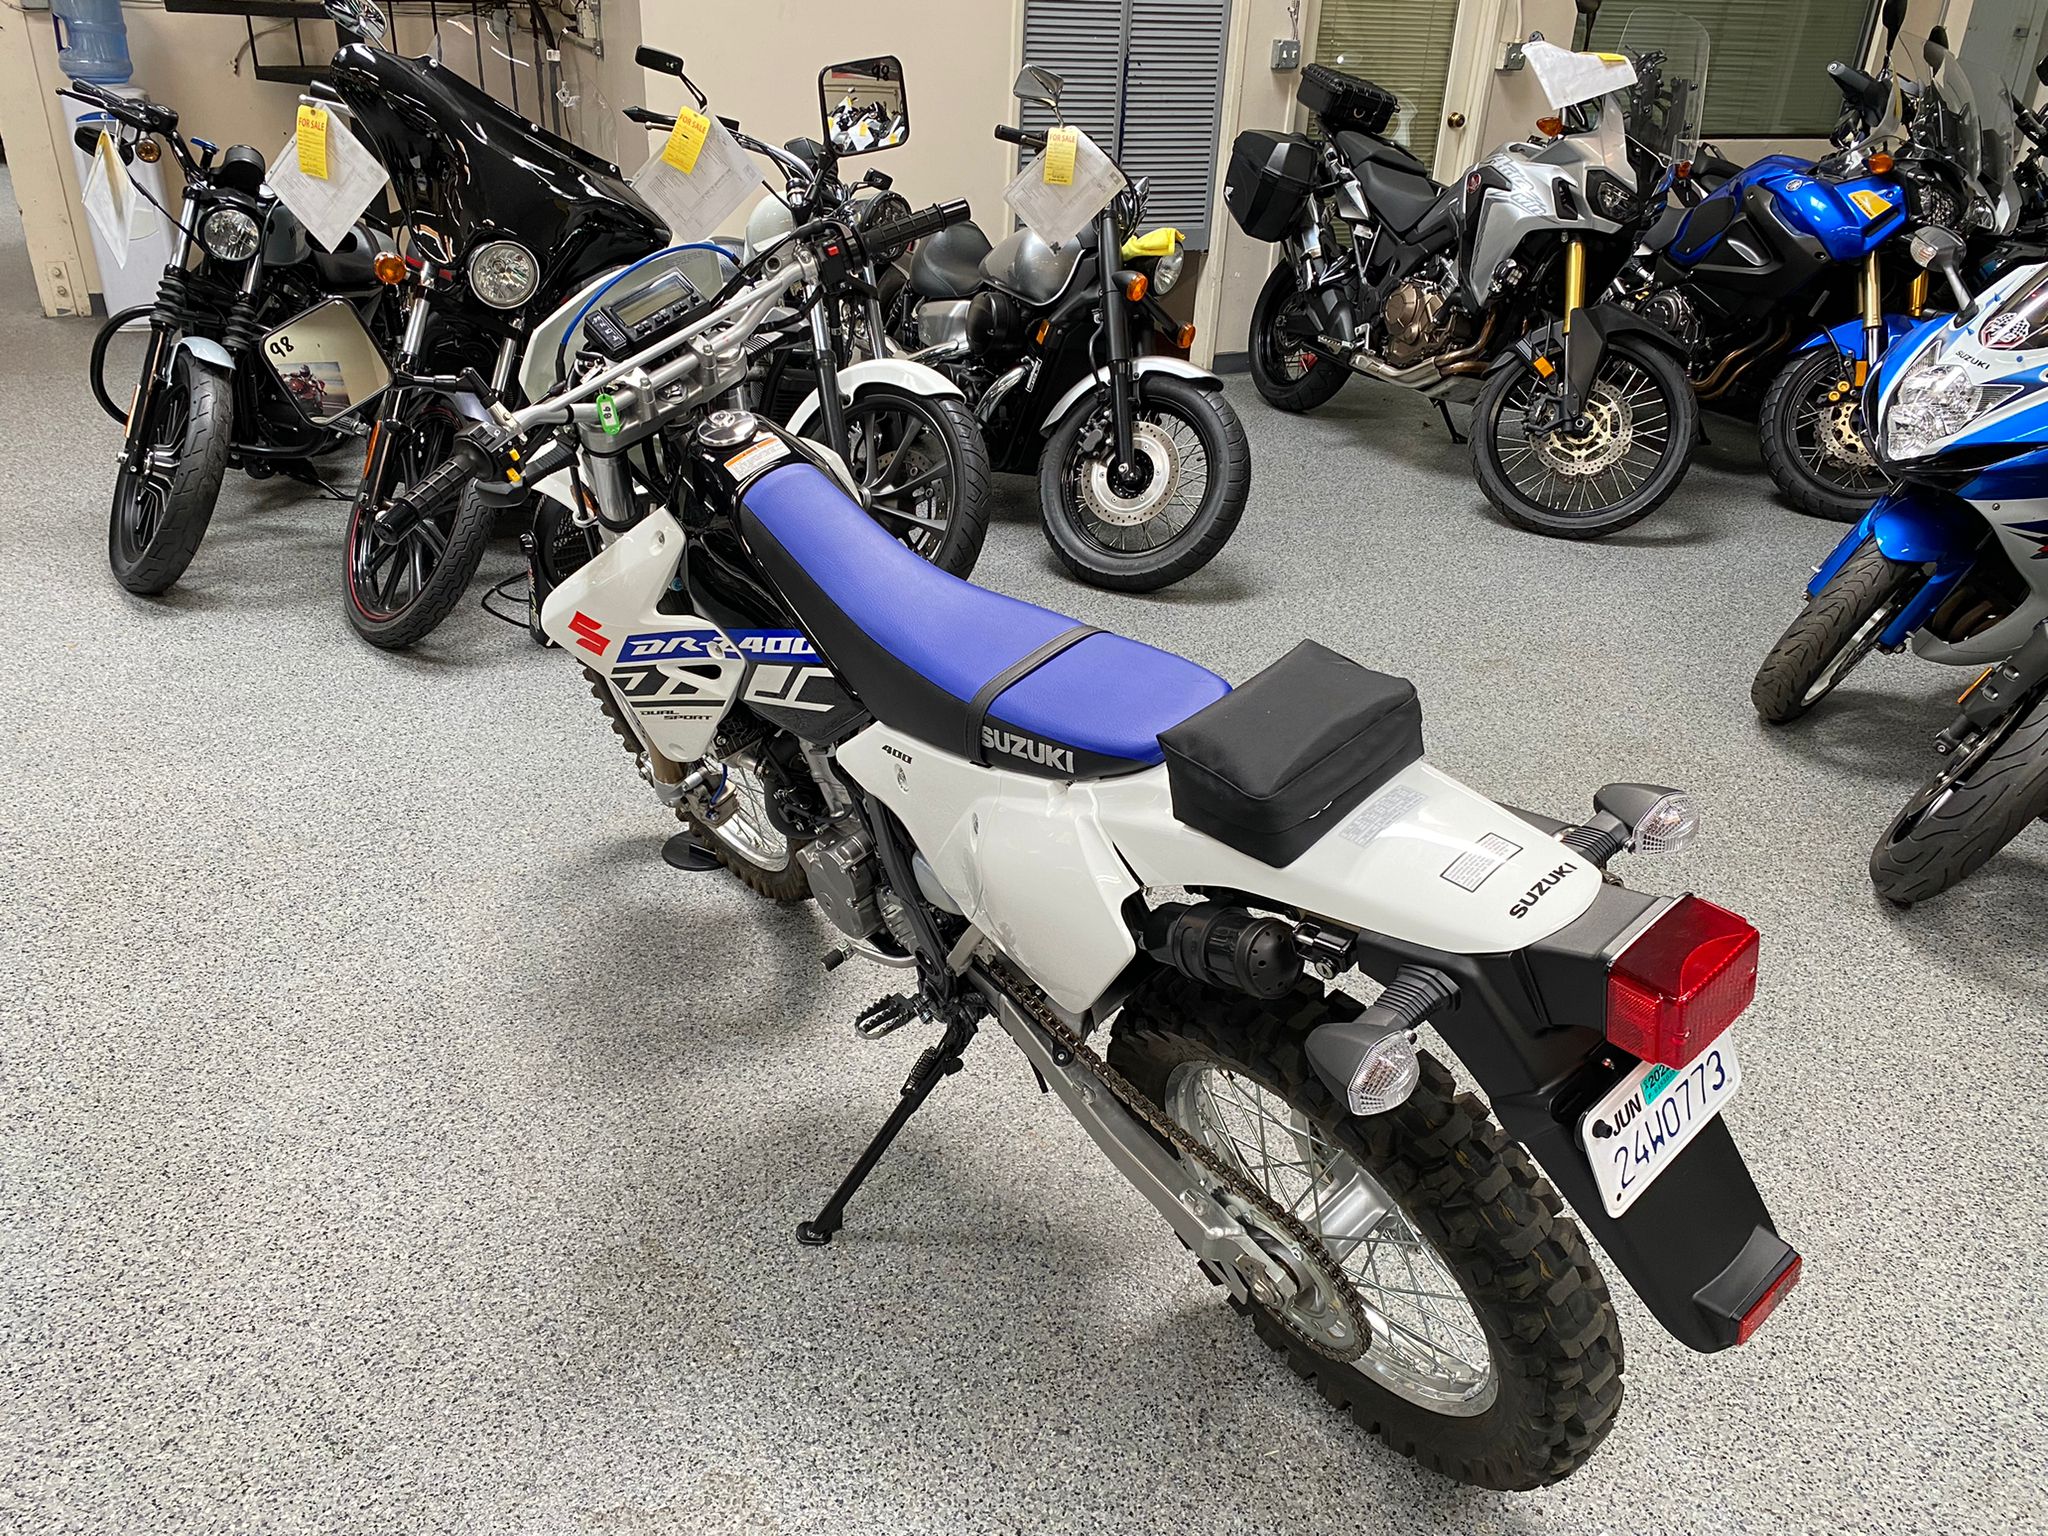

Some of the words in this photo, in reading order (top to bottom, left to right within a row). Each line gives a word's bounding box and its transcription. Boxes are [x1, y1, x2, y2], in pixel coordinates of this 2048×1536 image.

[298, 118, 310, 127] FOR
[311, 121, 325, 131] SALE
[680, 114, 692, 126] FOR
[691, 122, 707, 134] SALE
[1050, 133, 1061, 141] FOR
[1062, 135, 1076, 143] SALE
[269, 336, 294, 357] 98
[1955, 350, 1991, 370] SUZUKI
[881, 744, 913, 764] 400
[982, 725, 1074, 773] SUZUKI
[1509, 862, 1578, 919] SUZUKI
[1648, 1064, 1670, 1088] 202
[1612, 1093, 1642, 1136] JUN
